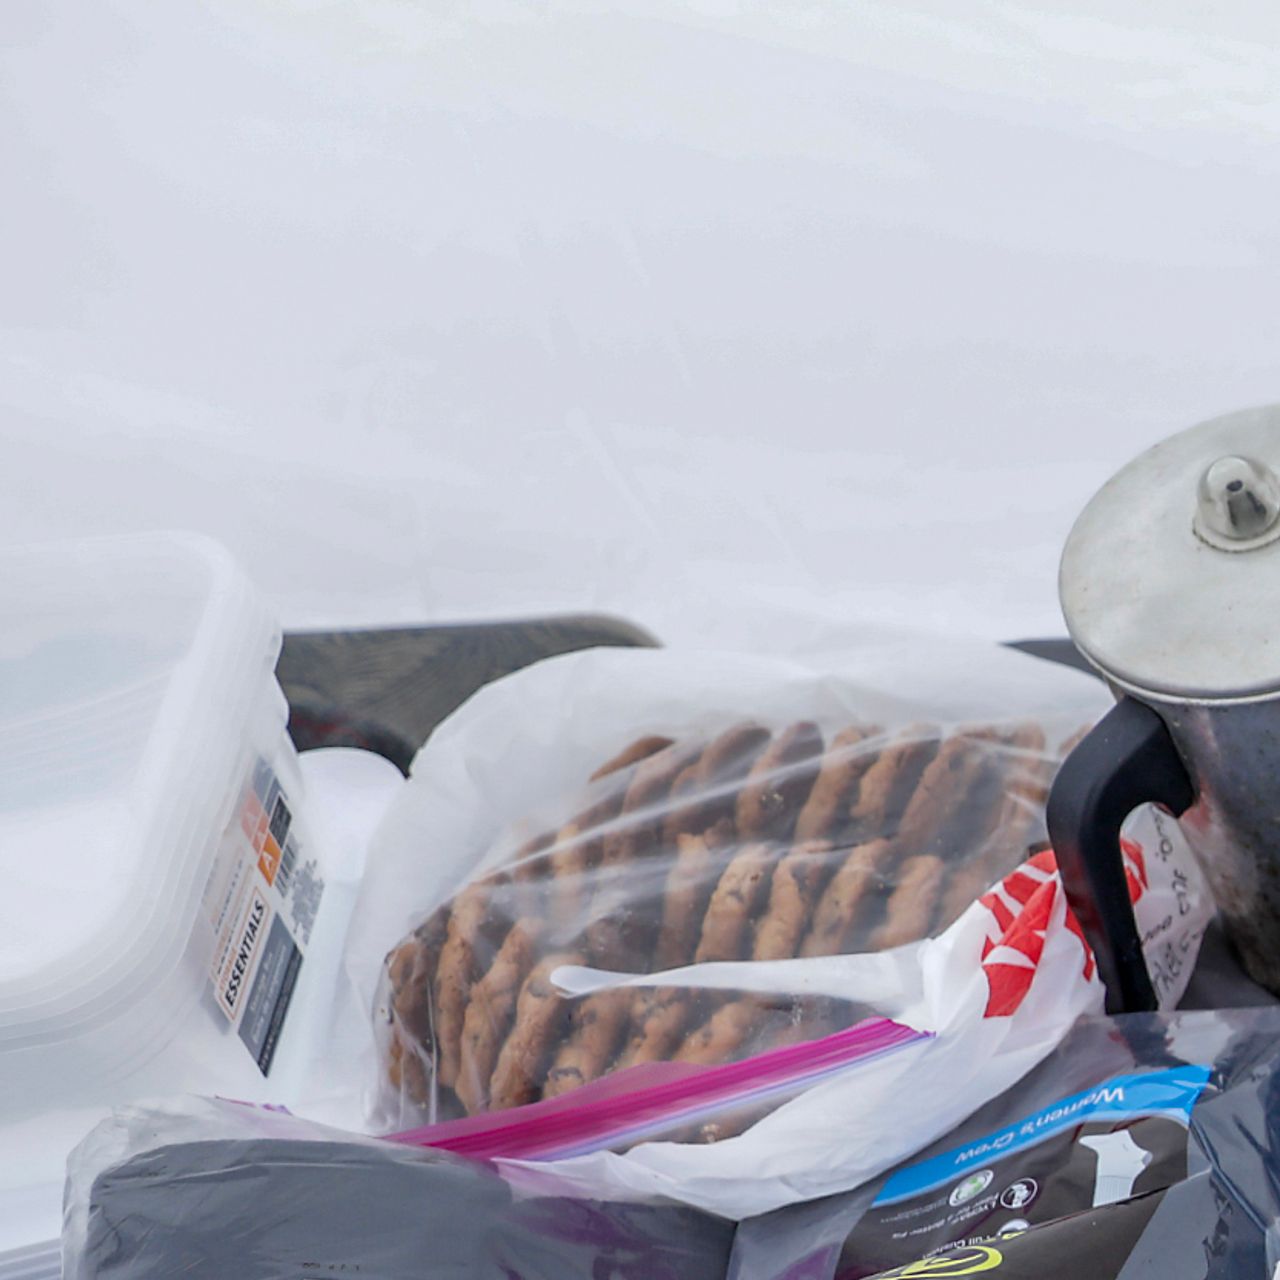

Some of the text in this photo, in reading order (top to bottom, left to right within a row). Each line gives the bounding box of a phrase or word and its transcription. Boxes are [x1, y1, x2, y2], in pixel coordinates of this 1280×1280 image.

[224, 900, 265, 1007] ESSENTIALS
[954, 1086, 1125, 1164] Women's Crew
